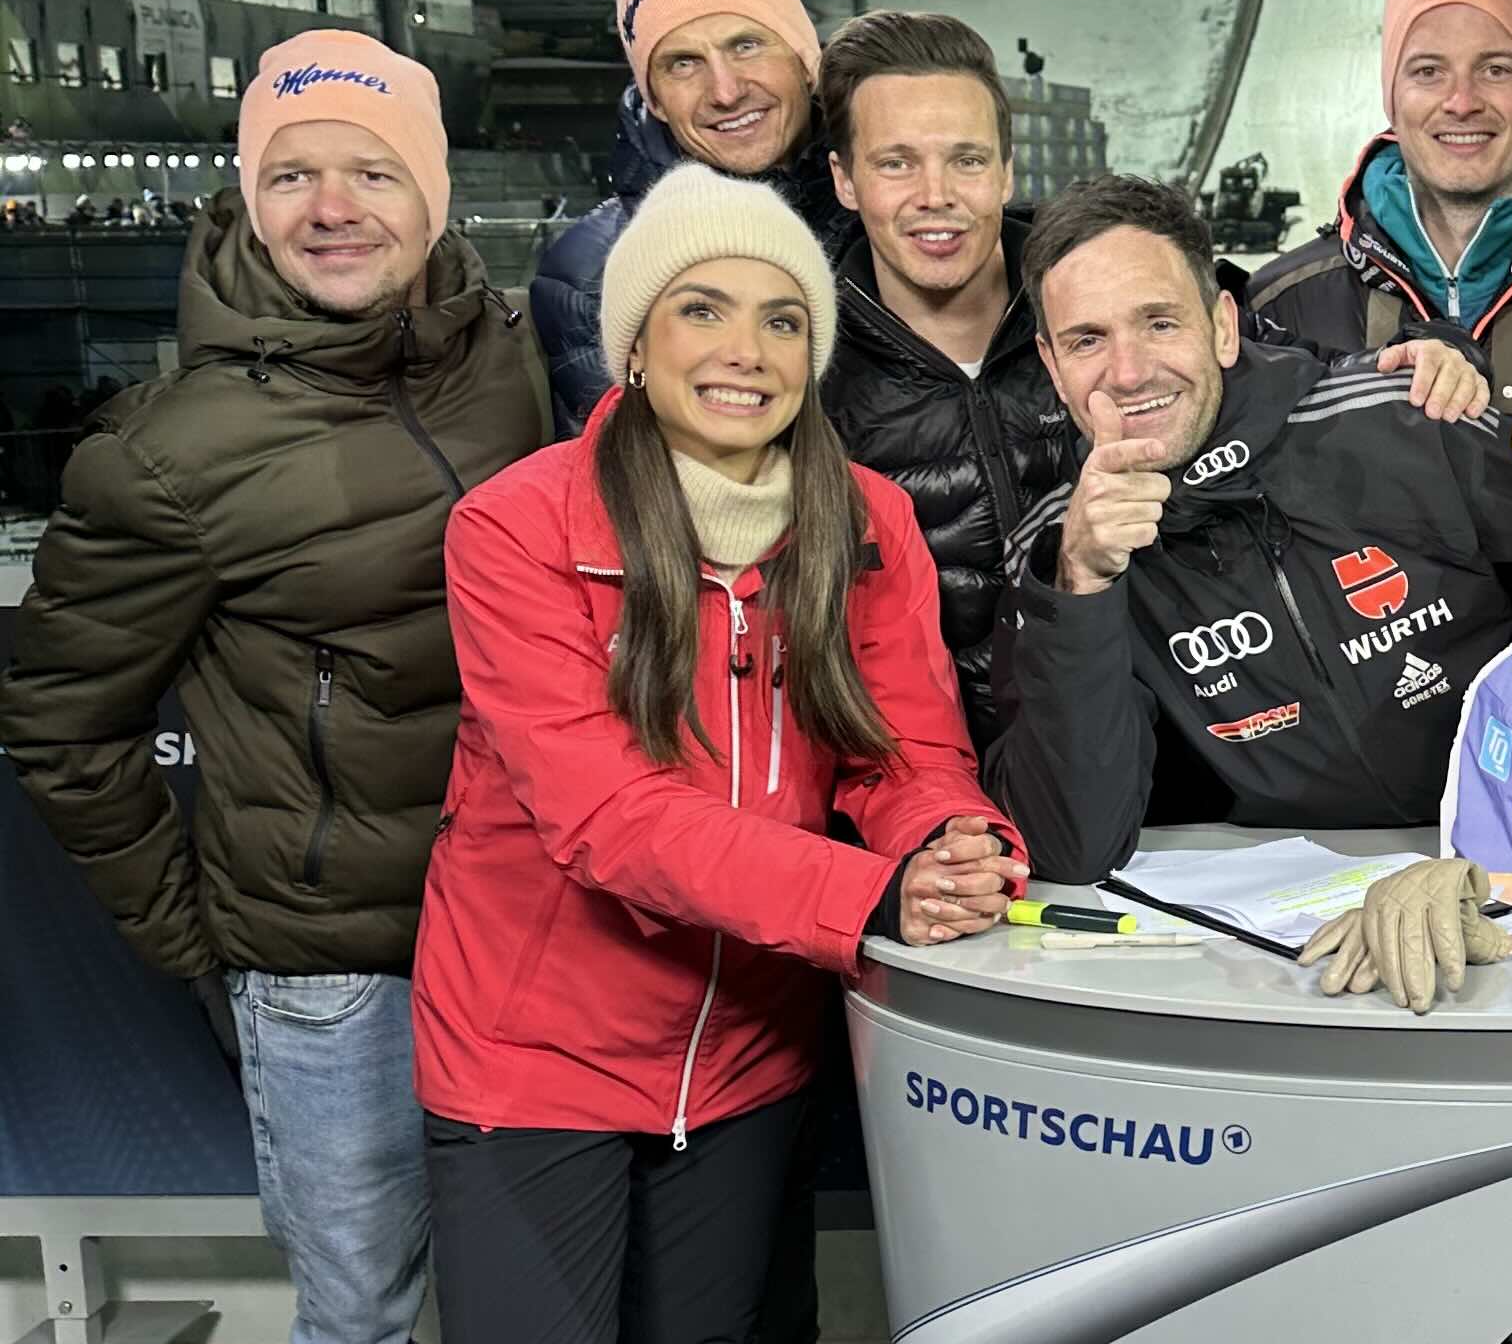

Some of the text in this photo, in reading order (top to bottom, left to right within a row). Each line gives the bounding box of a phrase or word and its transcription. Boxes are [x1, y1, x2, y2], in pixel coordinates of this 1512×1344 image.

[273, 62, 392, 99] Manner
[1340, 598, 1453, 665] WÜRTH
[1194, 672, 1238, 697] Audi
[1394, 663, 1442, 698] adidas
[906, 1072, 1214, 1165] SPORTSCHAU
